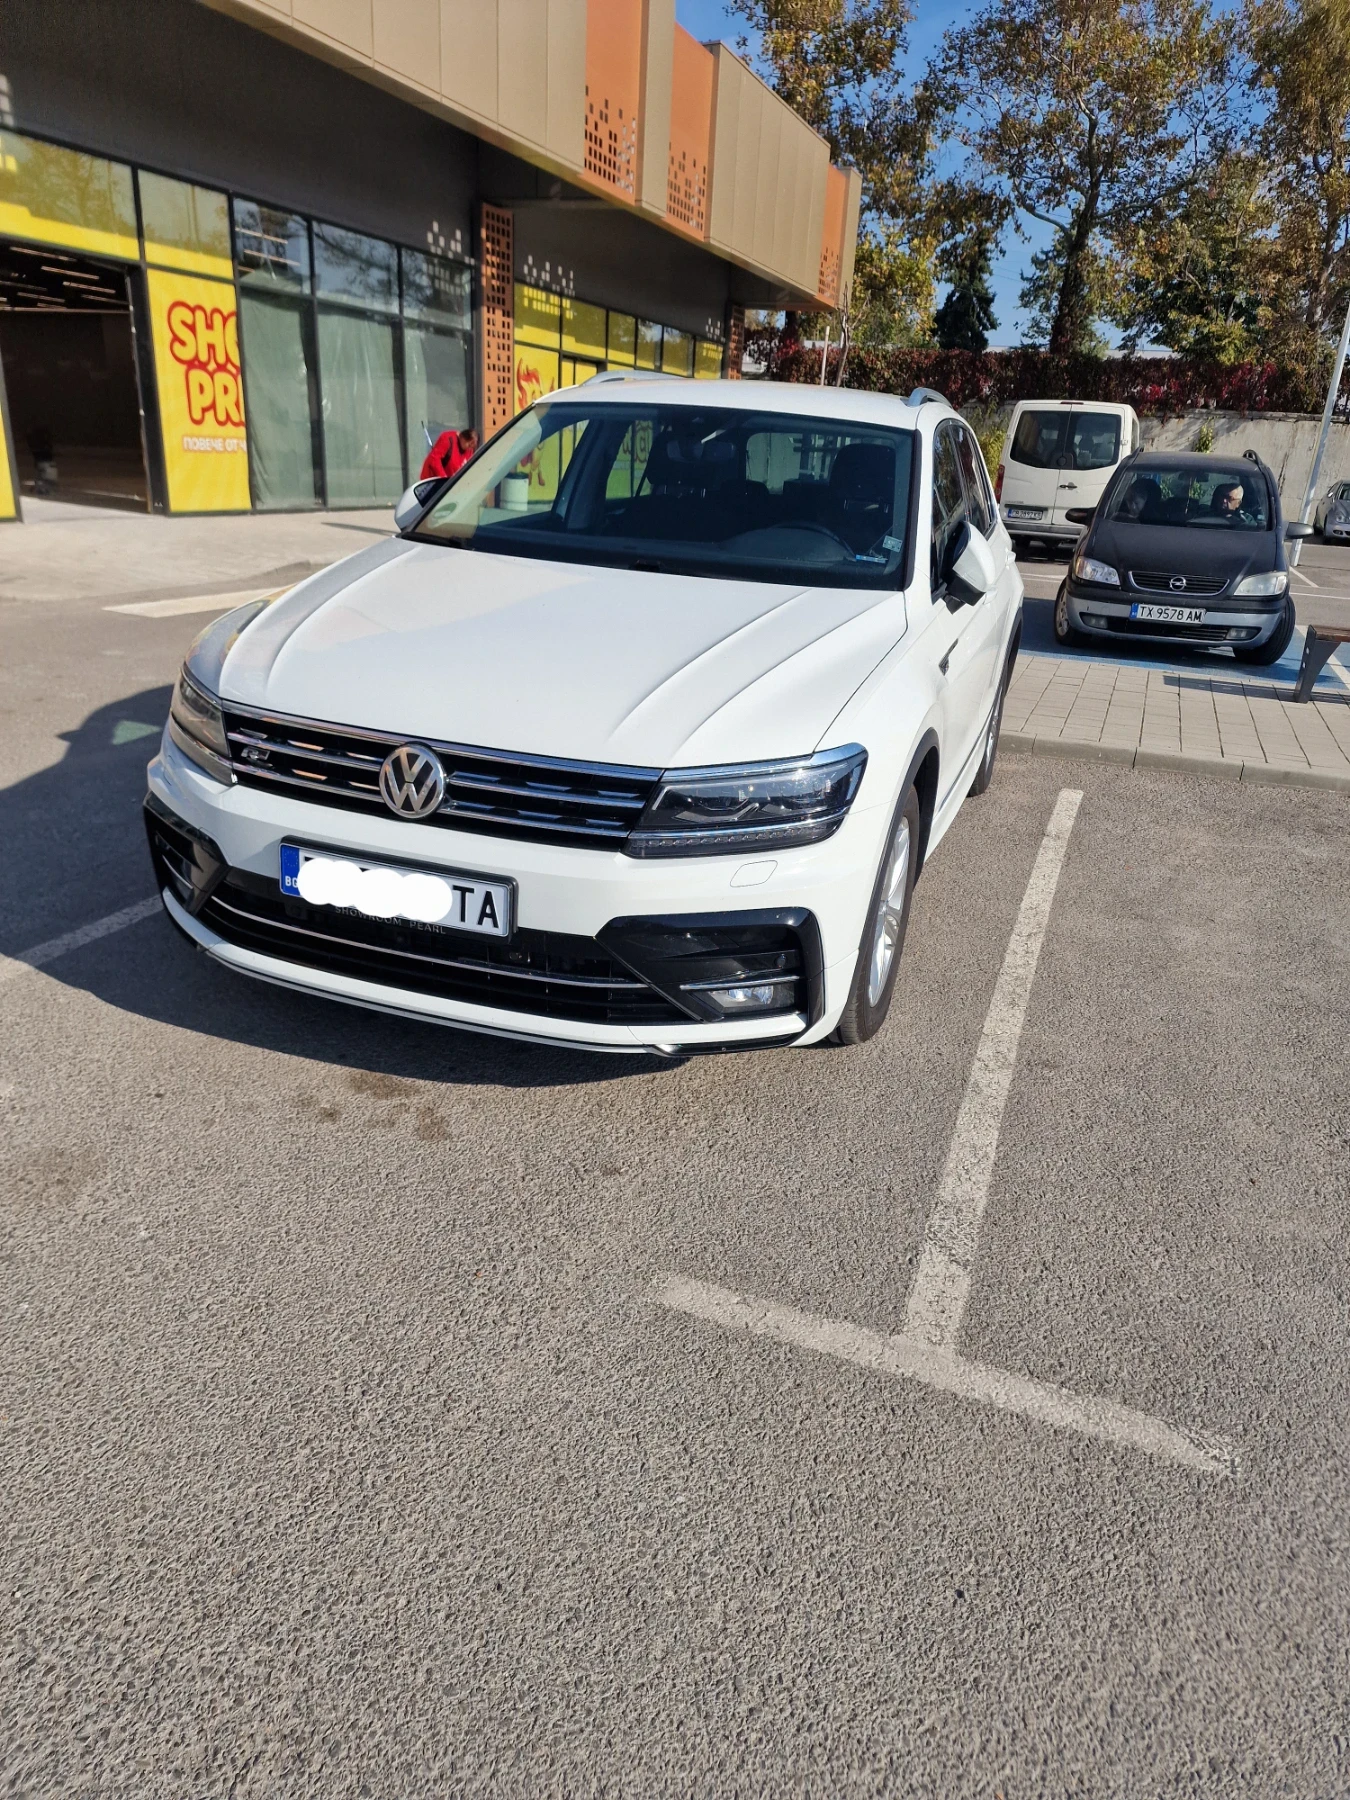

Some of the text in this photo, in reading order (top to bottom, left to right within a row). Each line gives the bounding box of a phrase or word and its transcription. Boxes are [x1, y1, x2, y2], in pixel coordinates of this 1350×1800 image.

[1140, 606, 1154, 618] TX
[1157, 607, 1184, 621] 9578
[1186, 610, 1203, 622] AM
[452, 885, 499, 929] TA
[409, 921, 447, 934] PEARL
